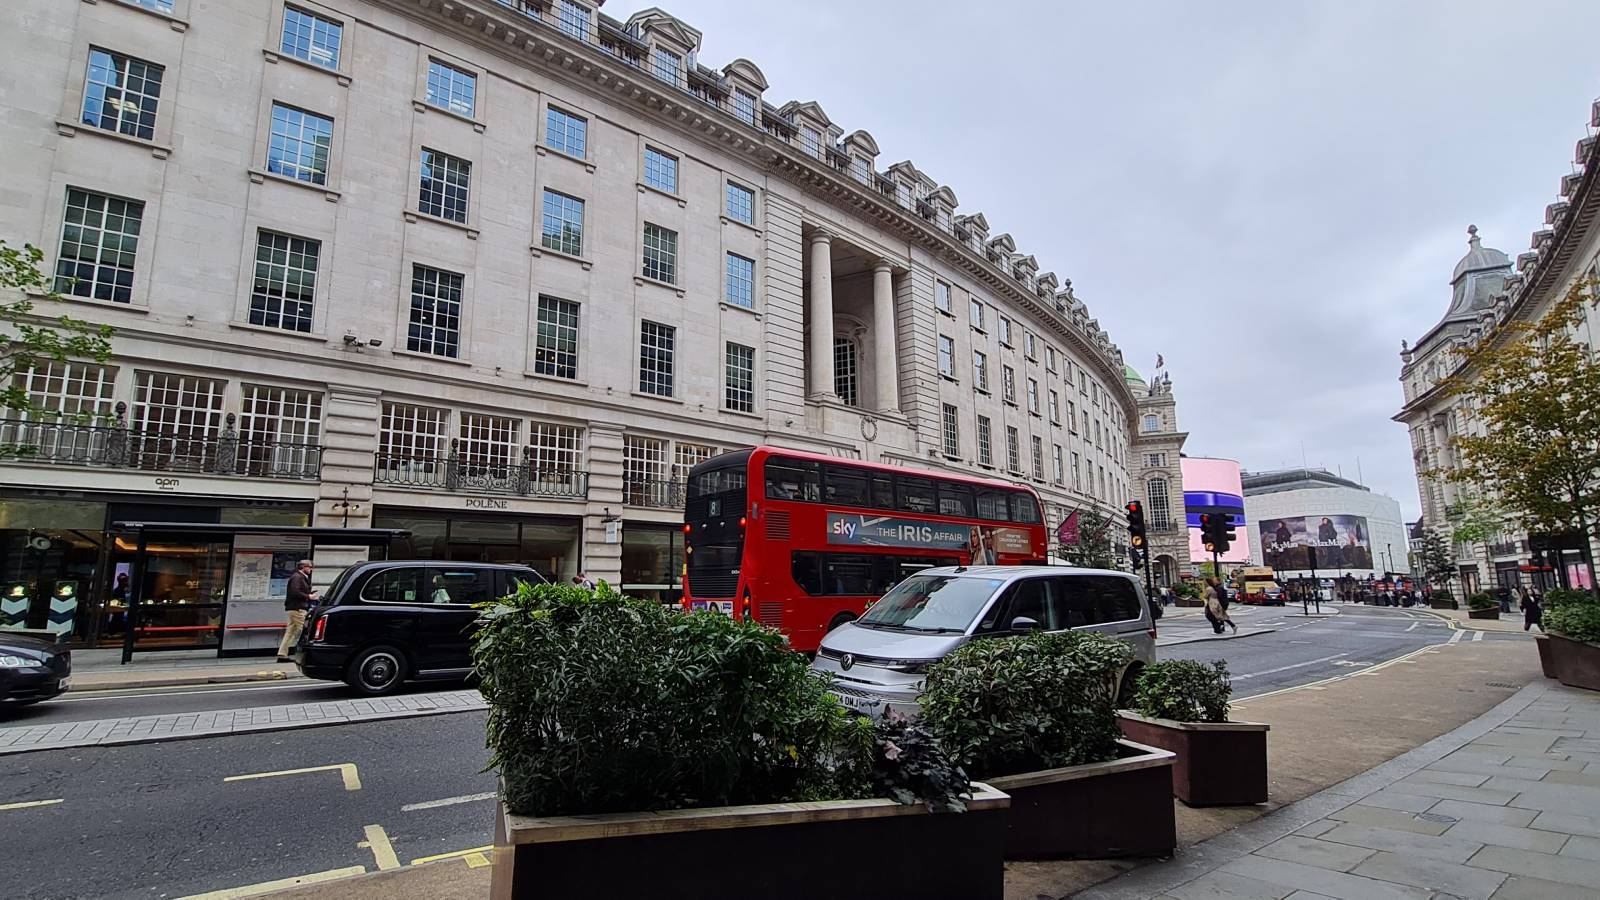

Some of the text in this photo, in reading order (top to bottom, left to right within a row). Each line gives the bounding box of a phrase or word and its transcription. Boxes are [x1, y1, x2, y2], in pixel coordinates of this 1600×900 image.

[156, 478, 180, 488] apm
[833, 518, 856, 538] sky
[877, 525, 963, 543] THE IRIS AFFAIR
